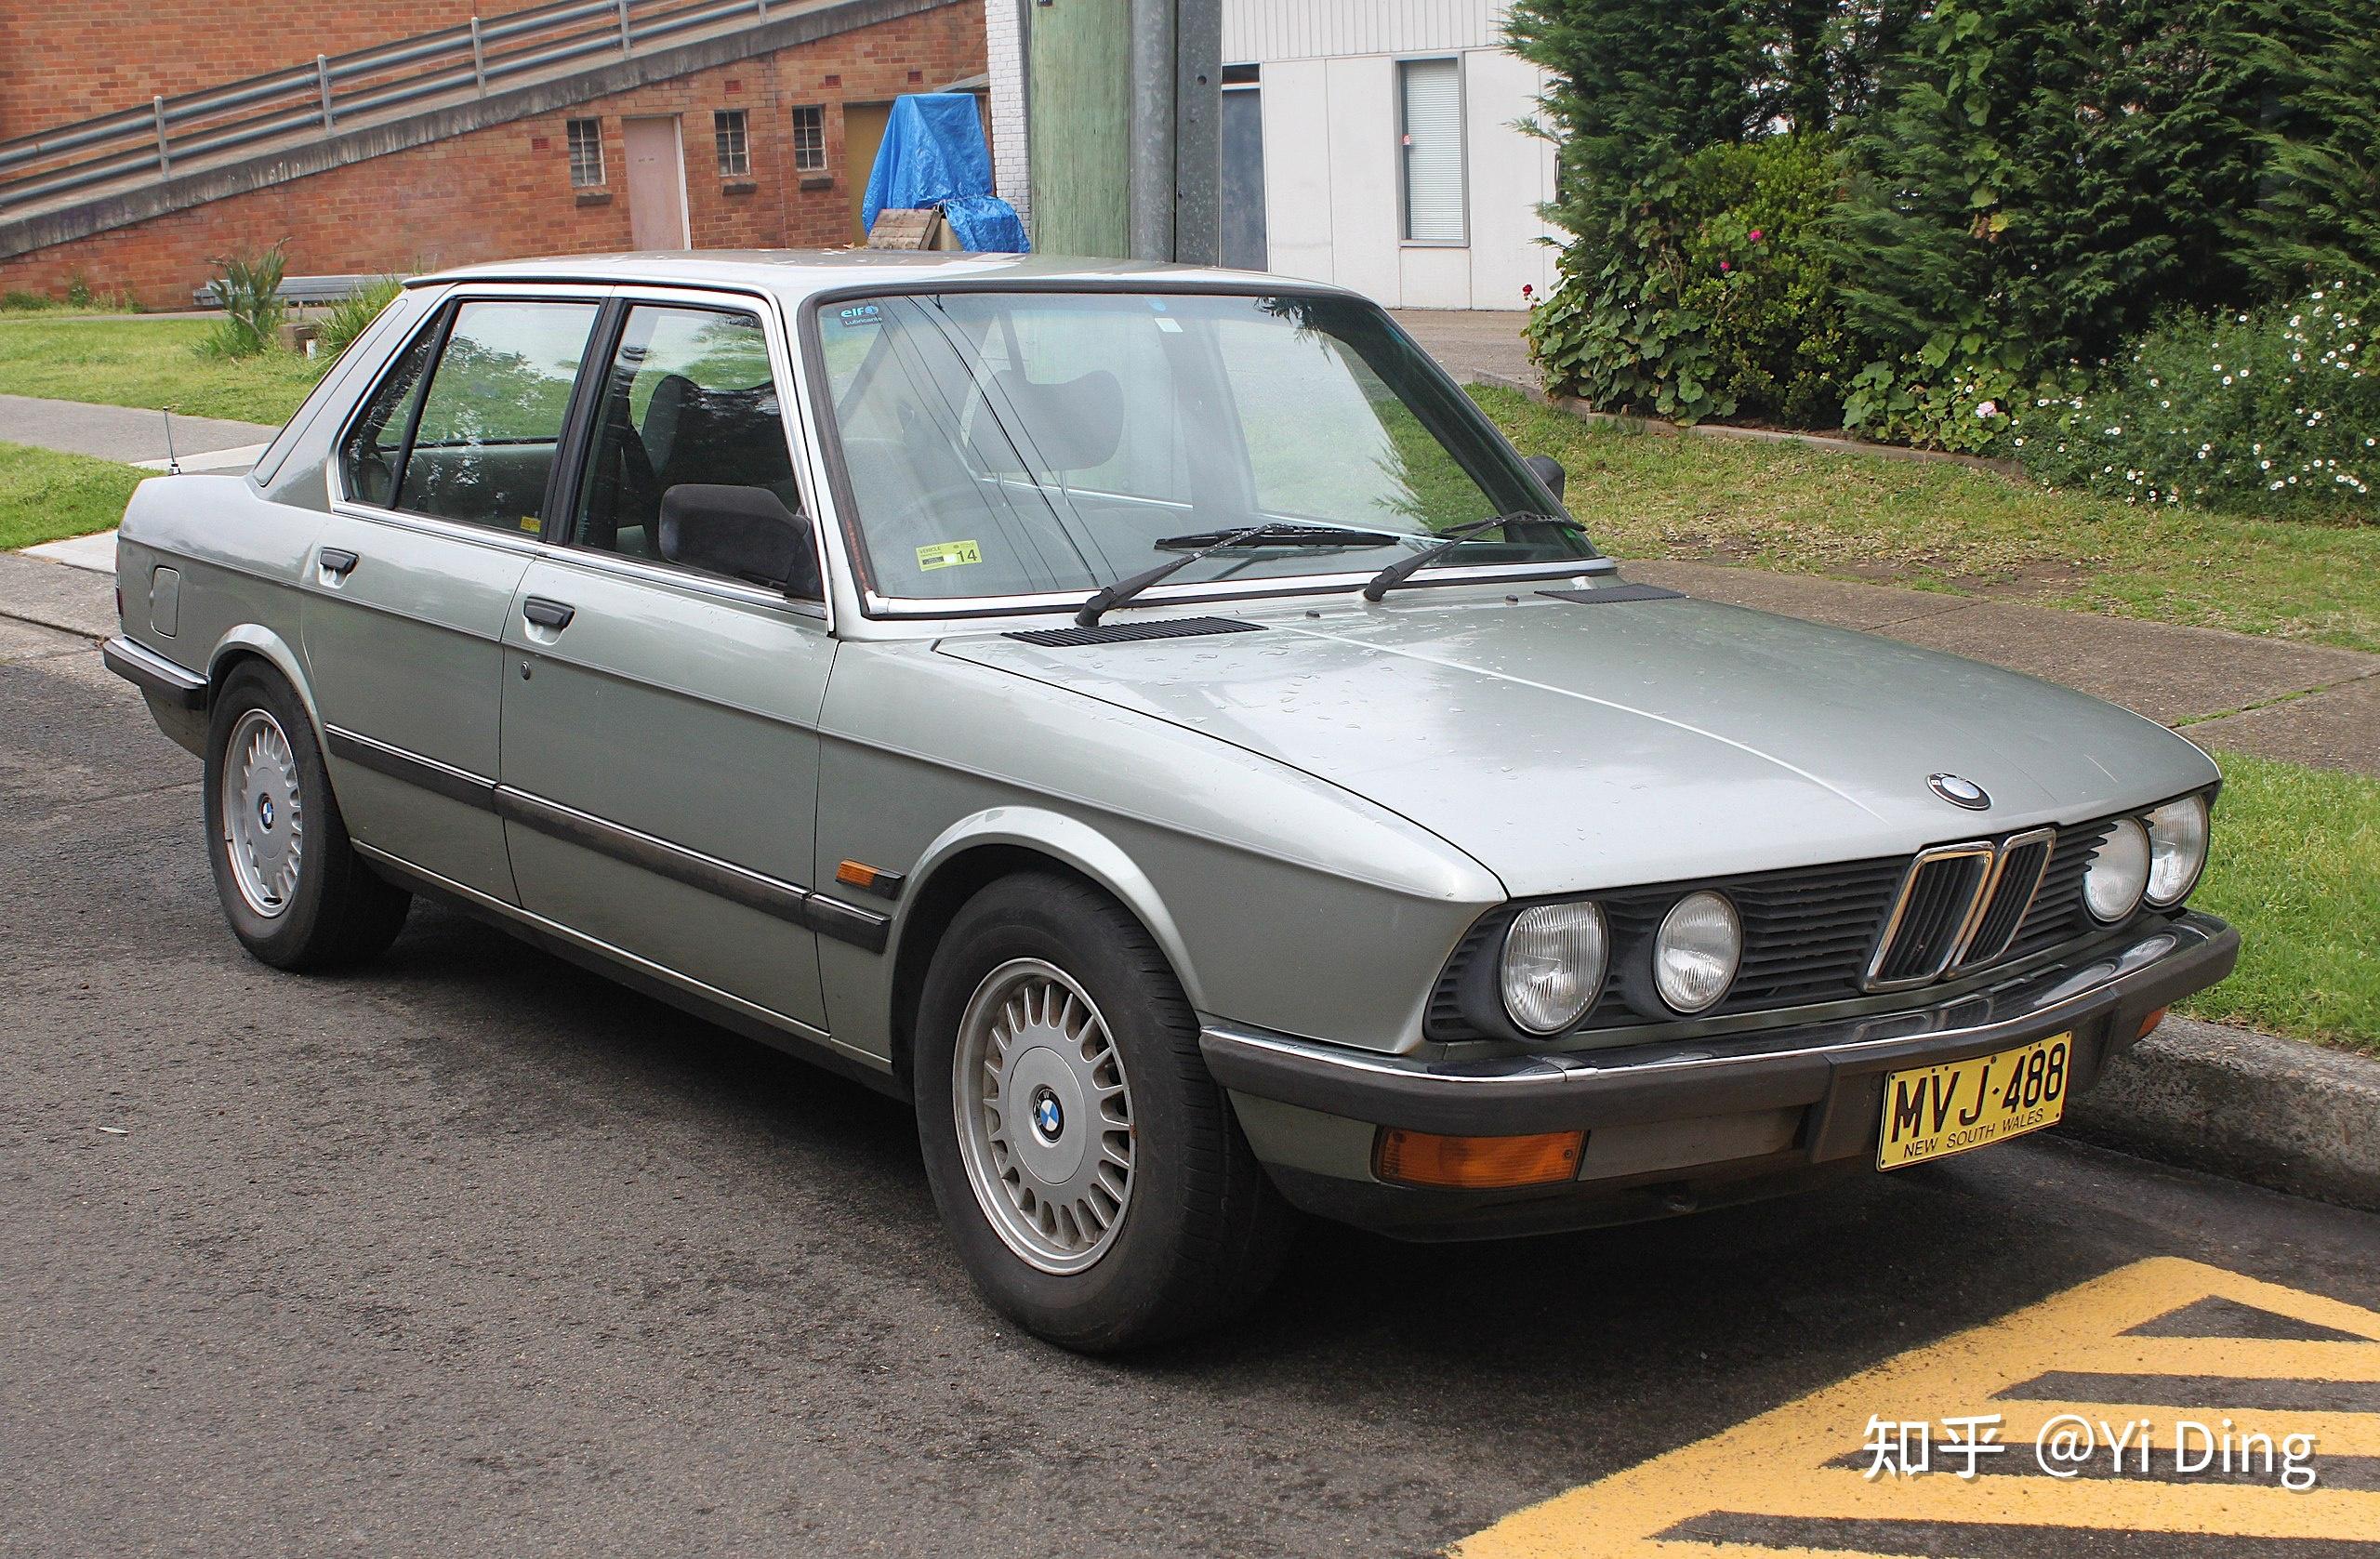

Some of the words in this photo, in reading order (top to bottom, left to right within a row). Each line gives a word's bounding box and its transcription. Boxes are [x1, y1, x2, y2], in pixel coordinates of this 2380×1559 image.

[840, 307, 864, 317] elf
[844, 316, 882, 325] Lubricants
[957, 548, 977, 562] 14
[1903, 1137, 1938, 1158] NEW
[1946, 1123, 1996, 1148] SOUTH
[2003, 1107, 2043, 1132] WALES
